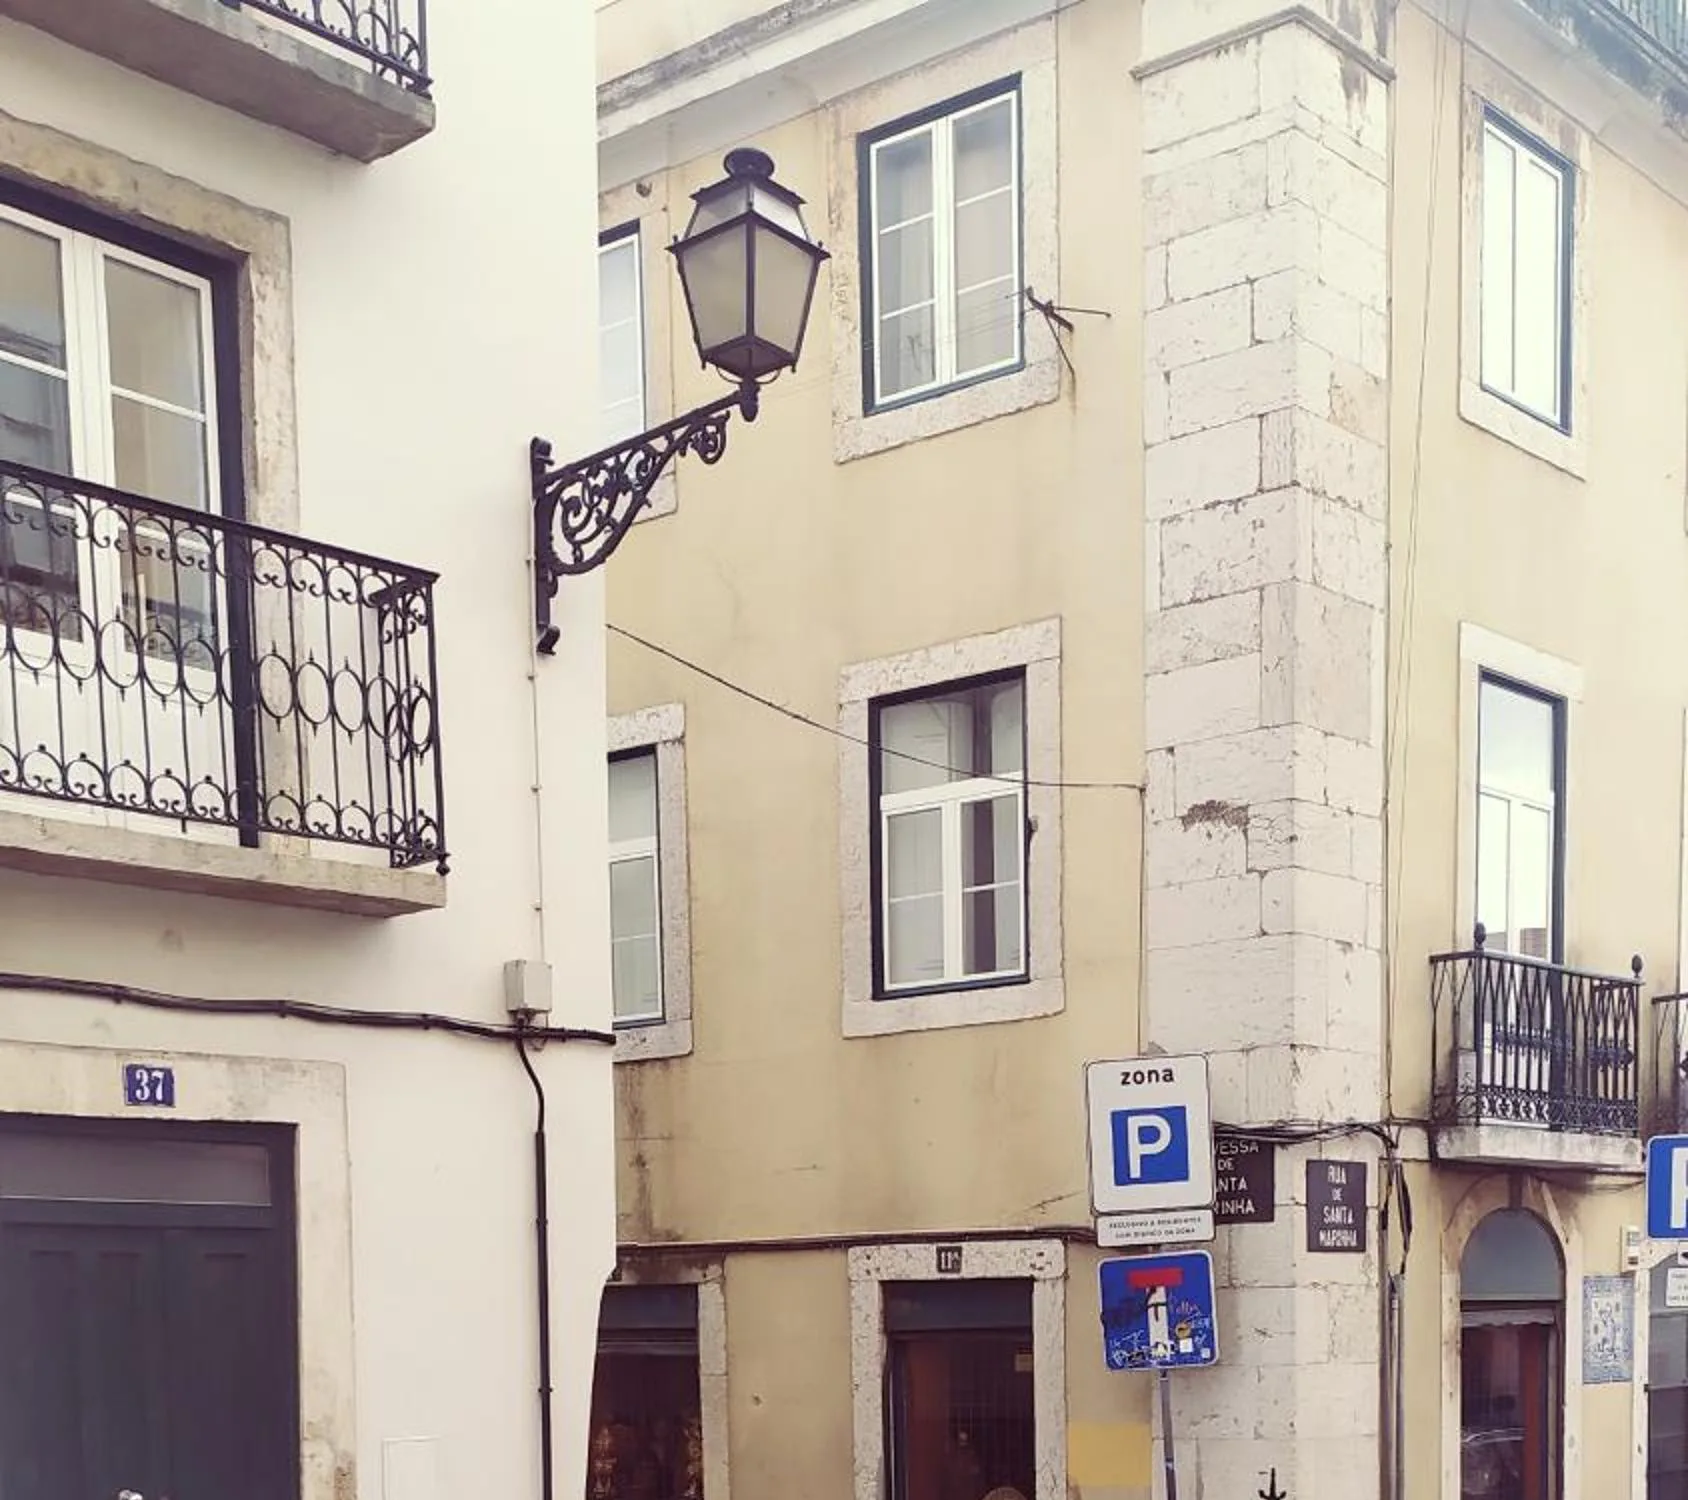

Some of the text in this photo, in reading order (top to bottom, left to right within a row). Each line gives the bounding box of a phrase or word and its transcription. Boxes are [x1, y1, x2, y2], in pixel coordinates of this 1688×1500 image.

[135, 1069, 165, 1101] 37
[1120, 1067, 1175, 1086] zona
[1127, 1115, 1172, 1179] P
[1217, 1158, 1234, 1171] DE
[1216, 1176, 1248, 1192] NTA
